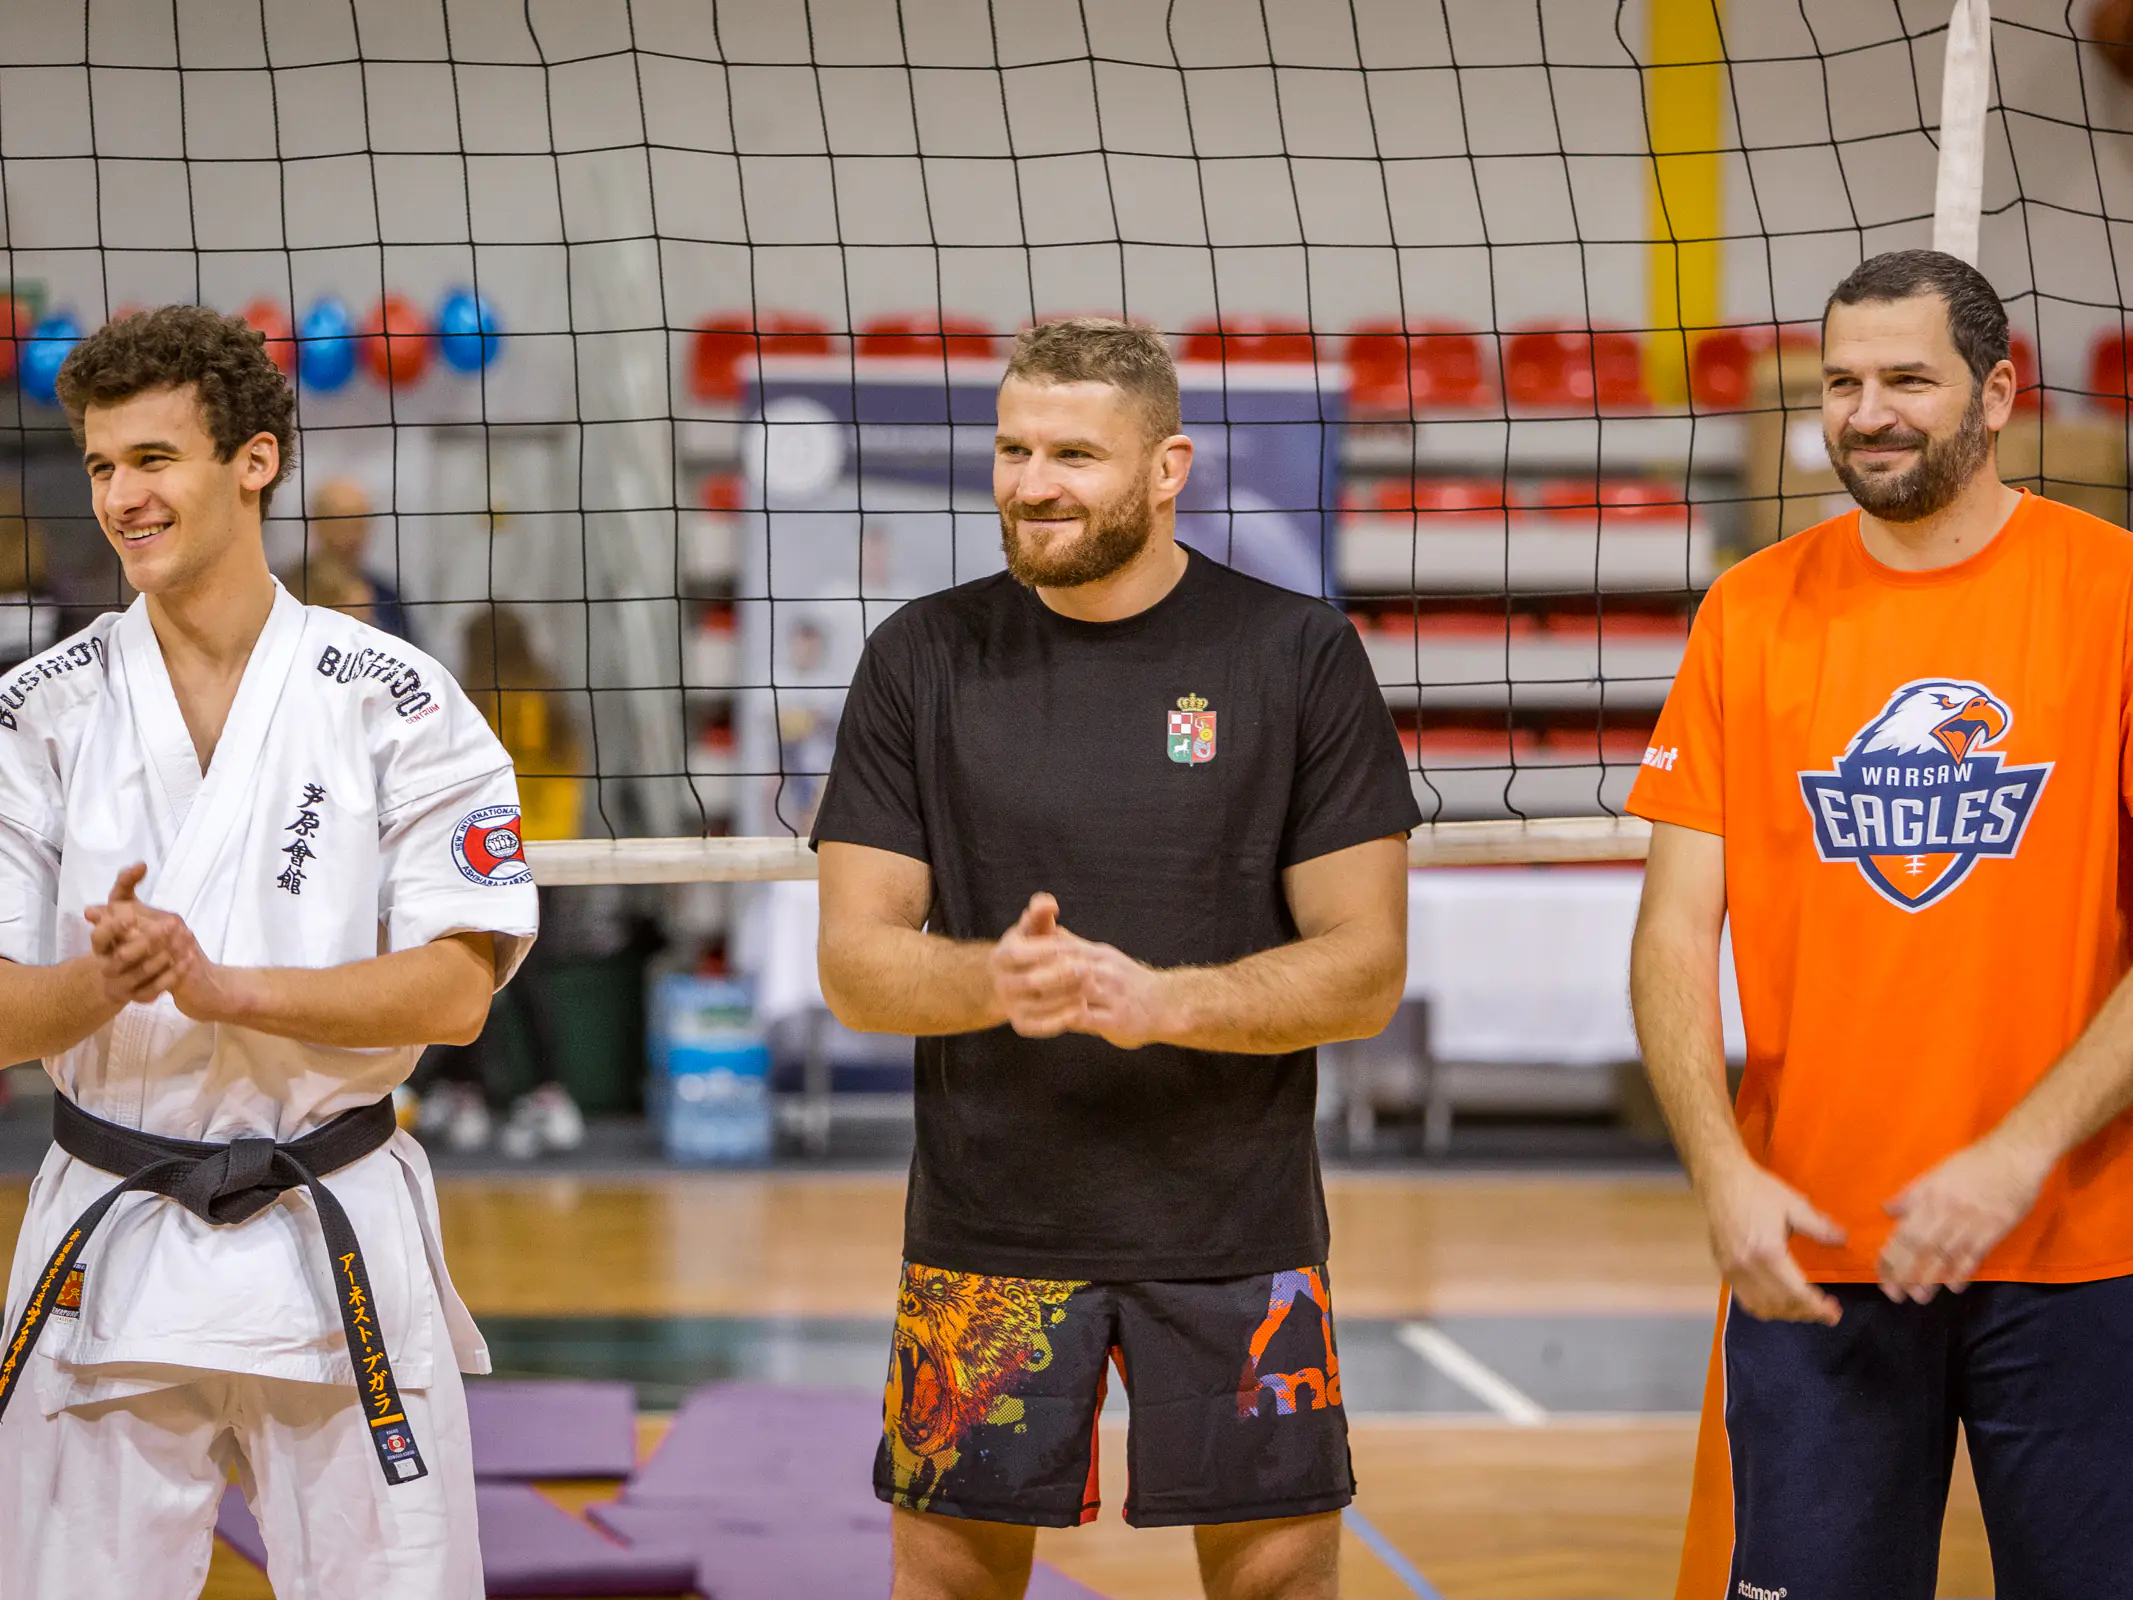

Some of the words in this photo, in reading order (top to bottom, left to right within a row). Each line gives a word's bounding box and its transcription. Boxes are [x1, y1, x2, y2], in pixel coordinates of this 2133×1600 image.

[316, 644, 432, 718] BUSHIDO
[405, 703, 441, 725] CENTRUM
[1861, 762, 1973, 788] WARSAW
[454, 835, 463, 852] NEW
[459, 807, 519, 832] INTERNATIONAL
[1815, 782, 2029, 848] EAGLES
[338, 1252, 392, 1415] アーネスト・ブガラ
